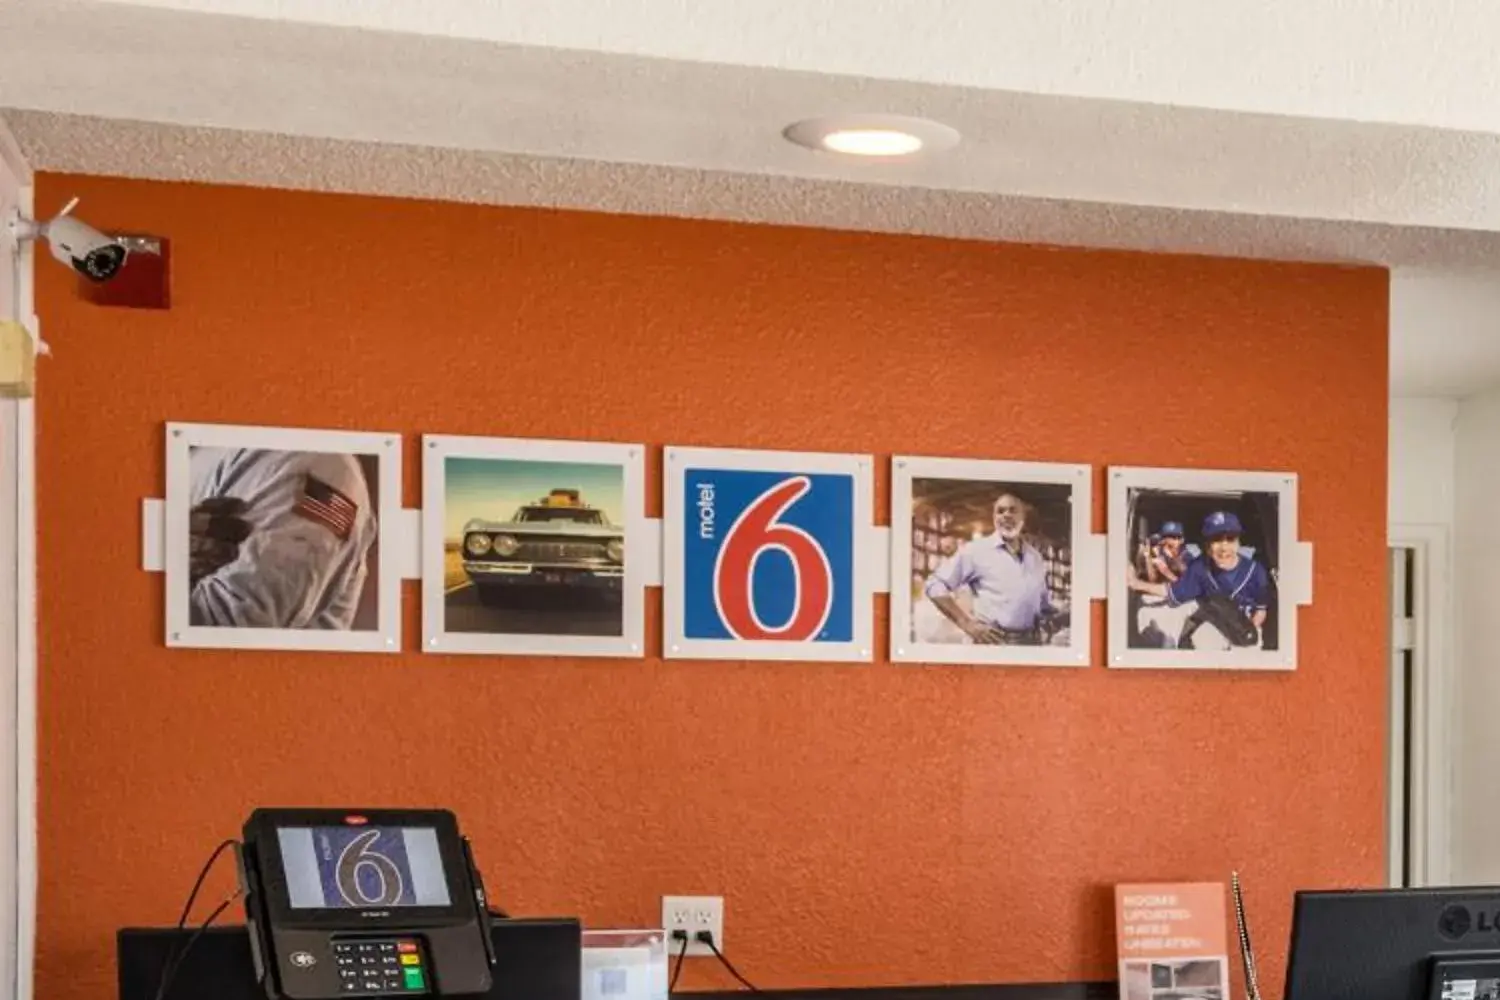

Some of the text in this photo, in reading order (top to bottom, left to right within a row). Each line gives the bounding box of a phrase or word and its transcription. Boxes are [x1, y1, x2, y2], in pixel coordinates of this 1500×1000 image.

[696, 475, 834, 642] motel 6
[335, 829, 403, 907] 6
